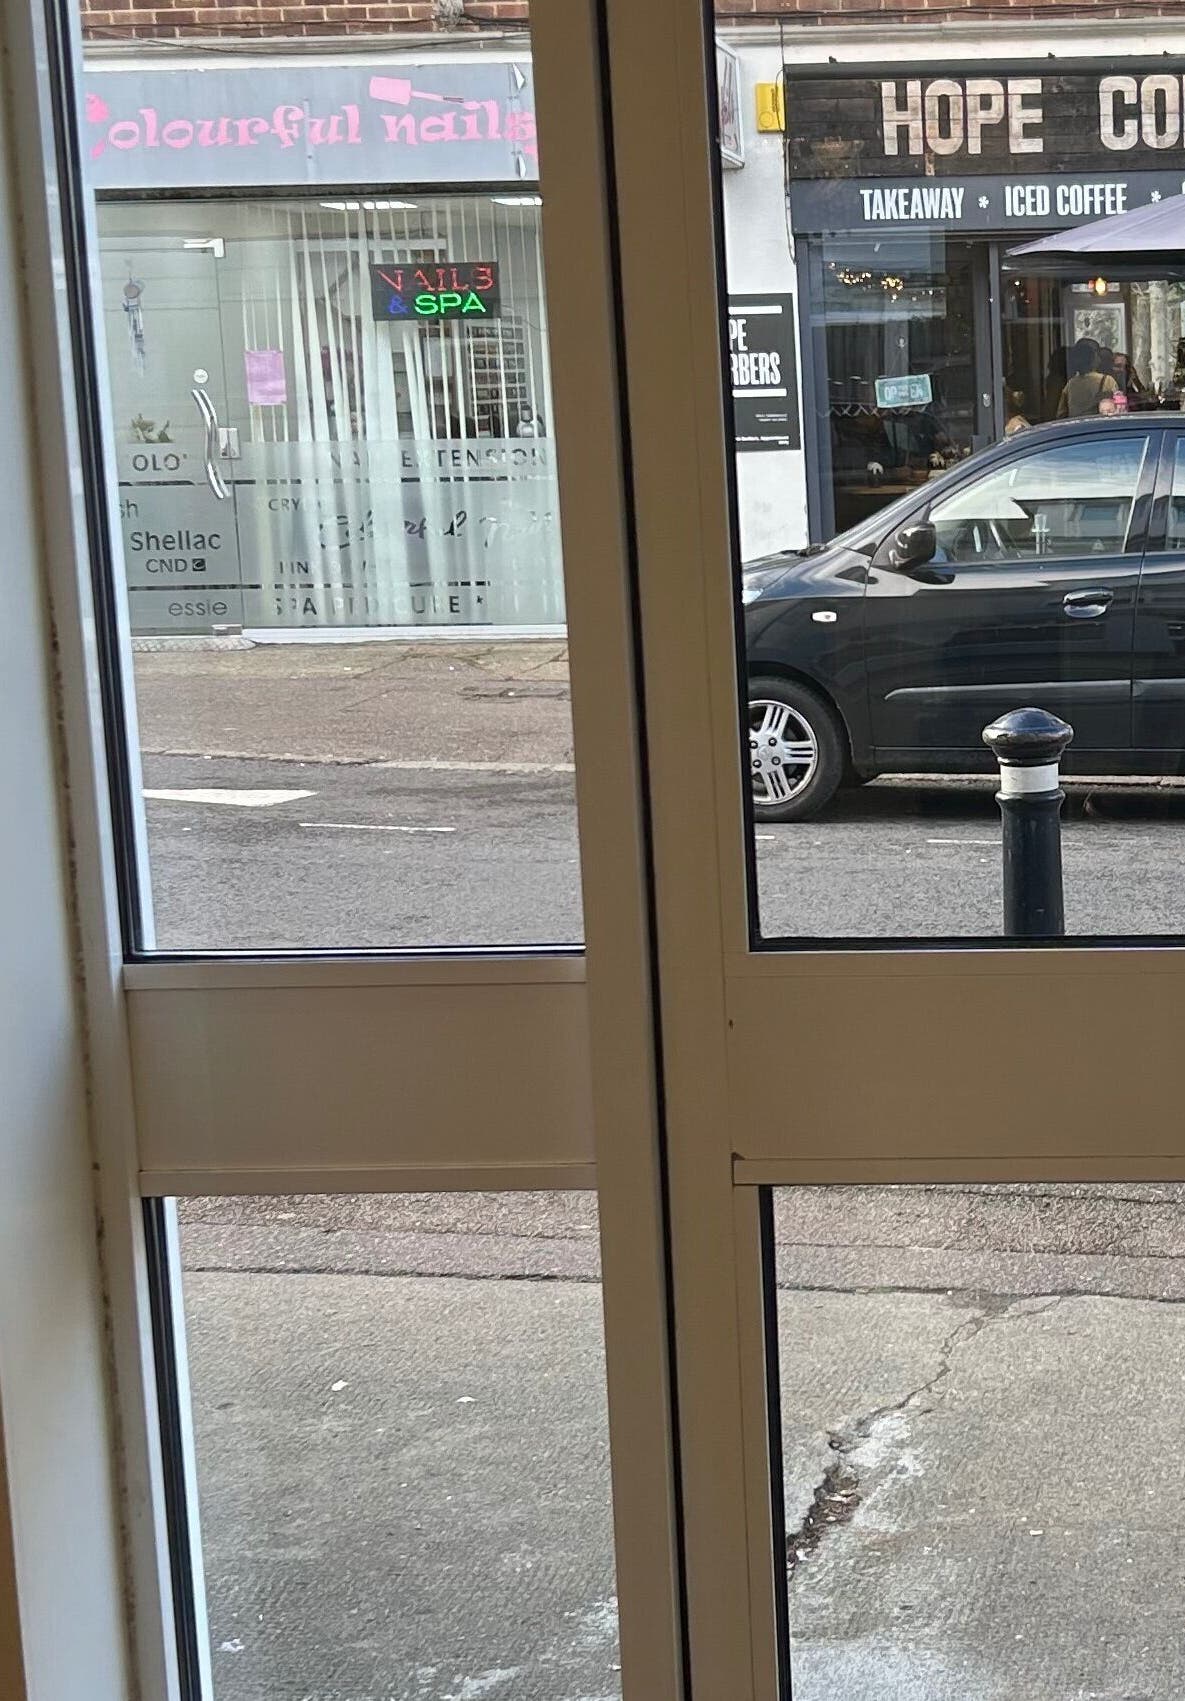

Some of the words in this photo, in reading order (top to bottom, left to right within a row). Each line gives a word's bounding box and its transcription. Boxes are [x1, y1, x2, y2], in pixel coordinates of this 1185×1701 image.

[86, 93, 362, 159] olourful
[881, 78, 1043, 155] HOPE
[860, 188, 964, 220] TAKEAWAY
[1005, 185, 1050, 216] ICED
[1056, 183, 1128, 215] COFFEE
[389, 294, 408, 314] &
[415, 292, 486, 315] SPA
[130, 530, 222, 551] Shellac
[145, 558, 188, 574] CND
[168, 602, 229, 617] essie
